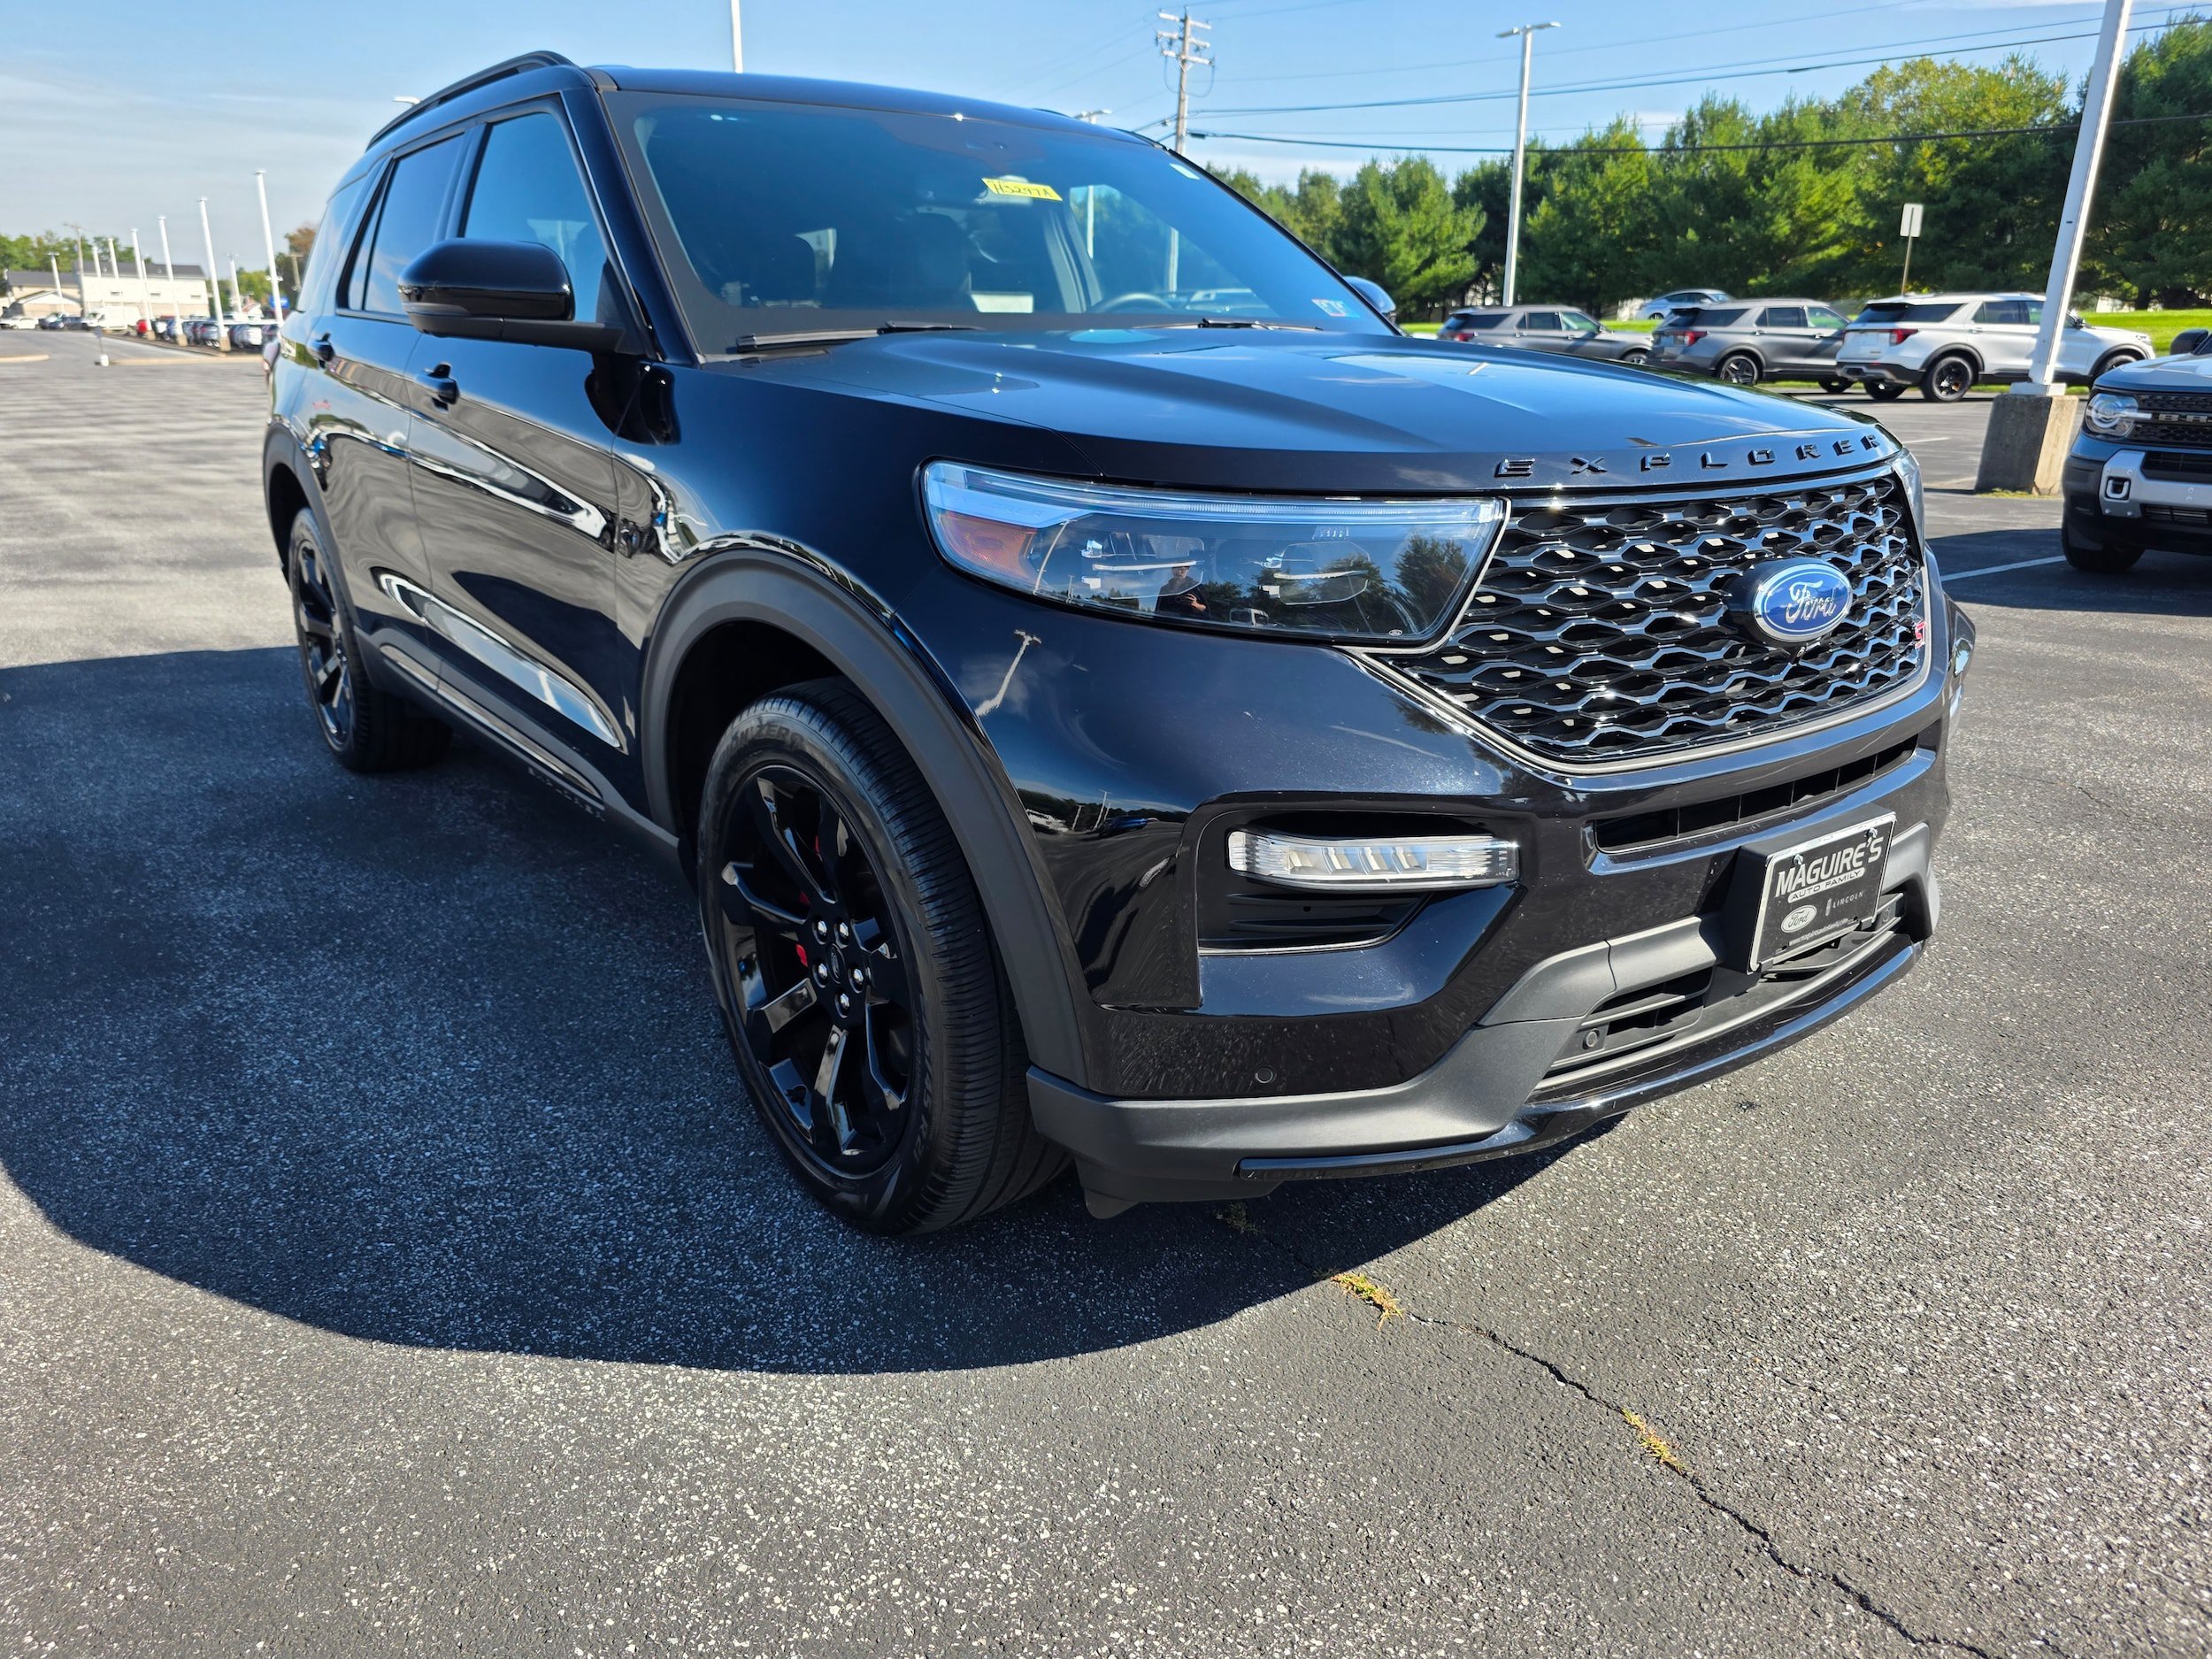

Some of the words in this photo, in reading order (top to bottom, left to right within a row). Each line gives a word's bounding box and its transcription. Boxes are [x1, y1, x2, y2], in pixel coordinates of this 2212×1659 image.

[1494, 434, 1883, 479] EXPLORER
[1784, 580, 1838, 625] Ford
[1775, 836, 1884, 897] MAGUIRE'S
[1791, 886, 1821, 900] AUTO
[1824, 869, 1862, 888] FAMILY
[1833, 891, 1863, 908] LINCOLN
